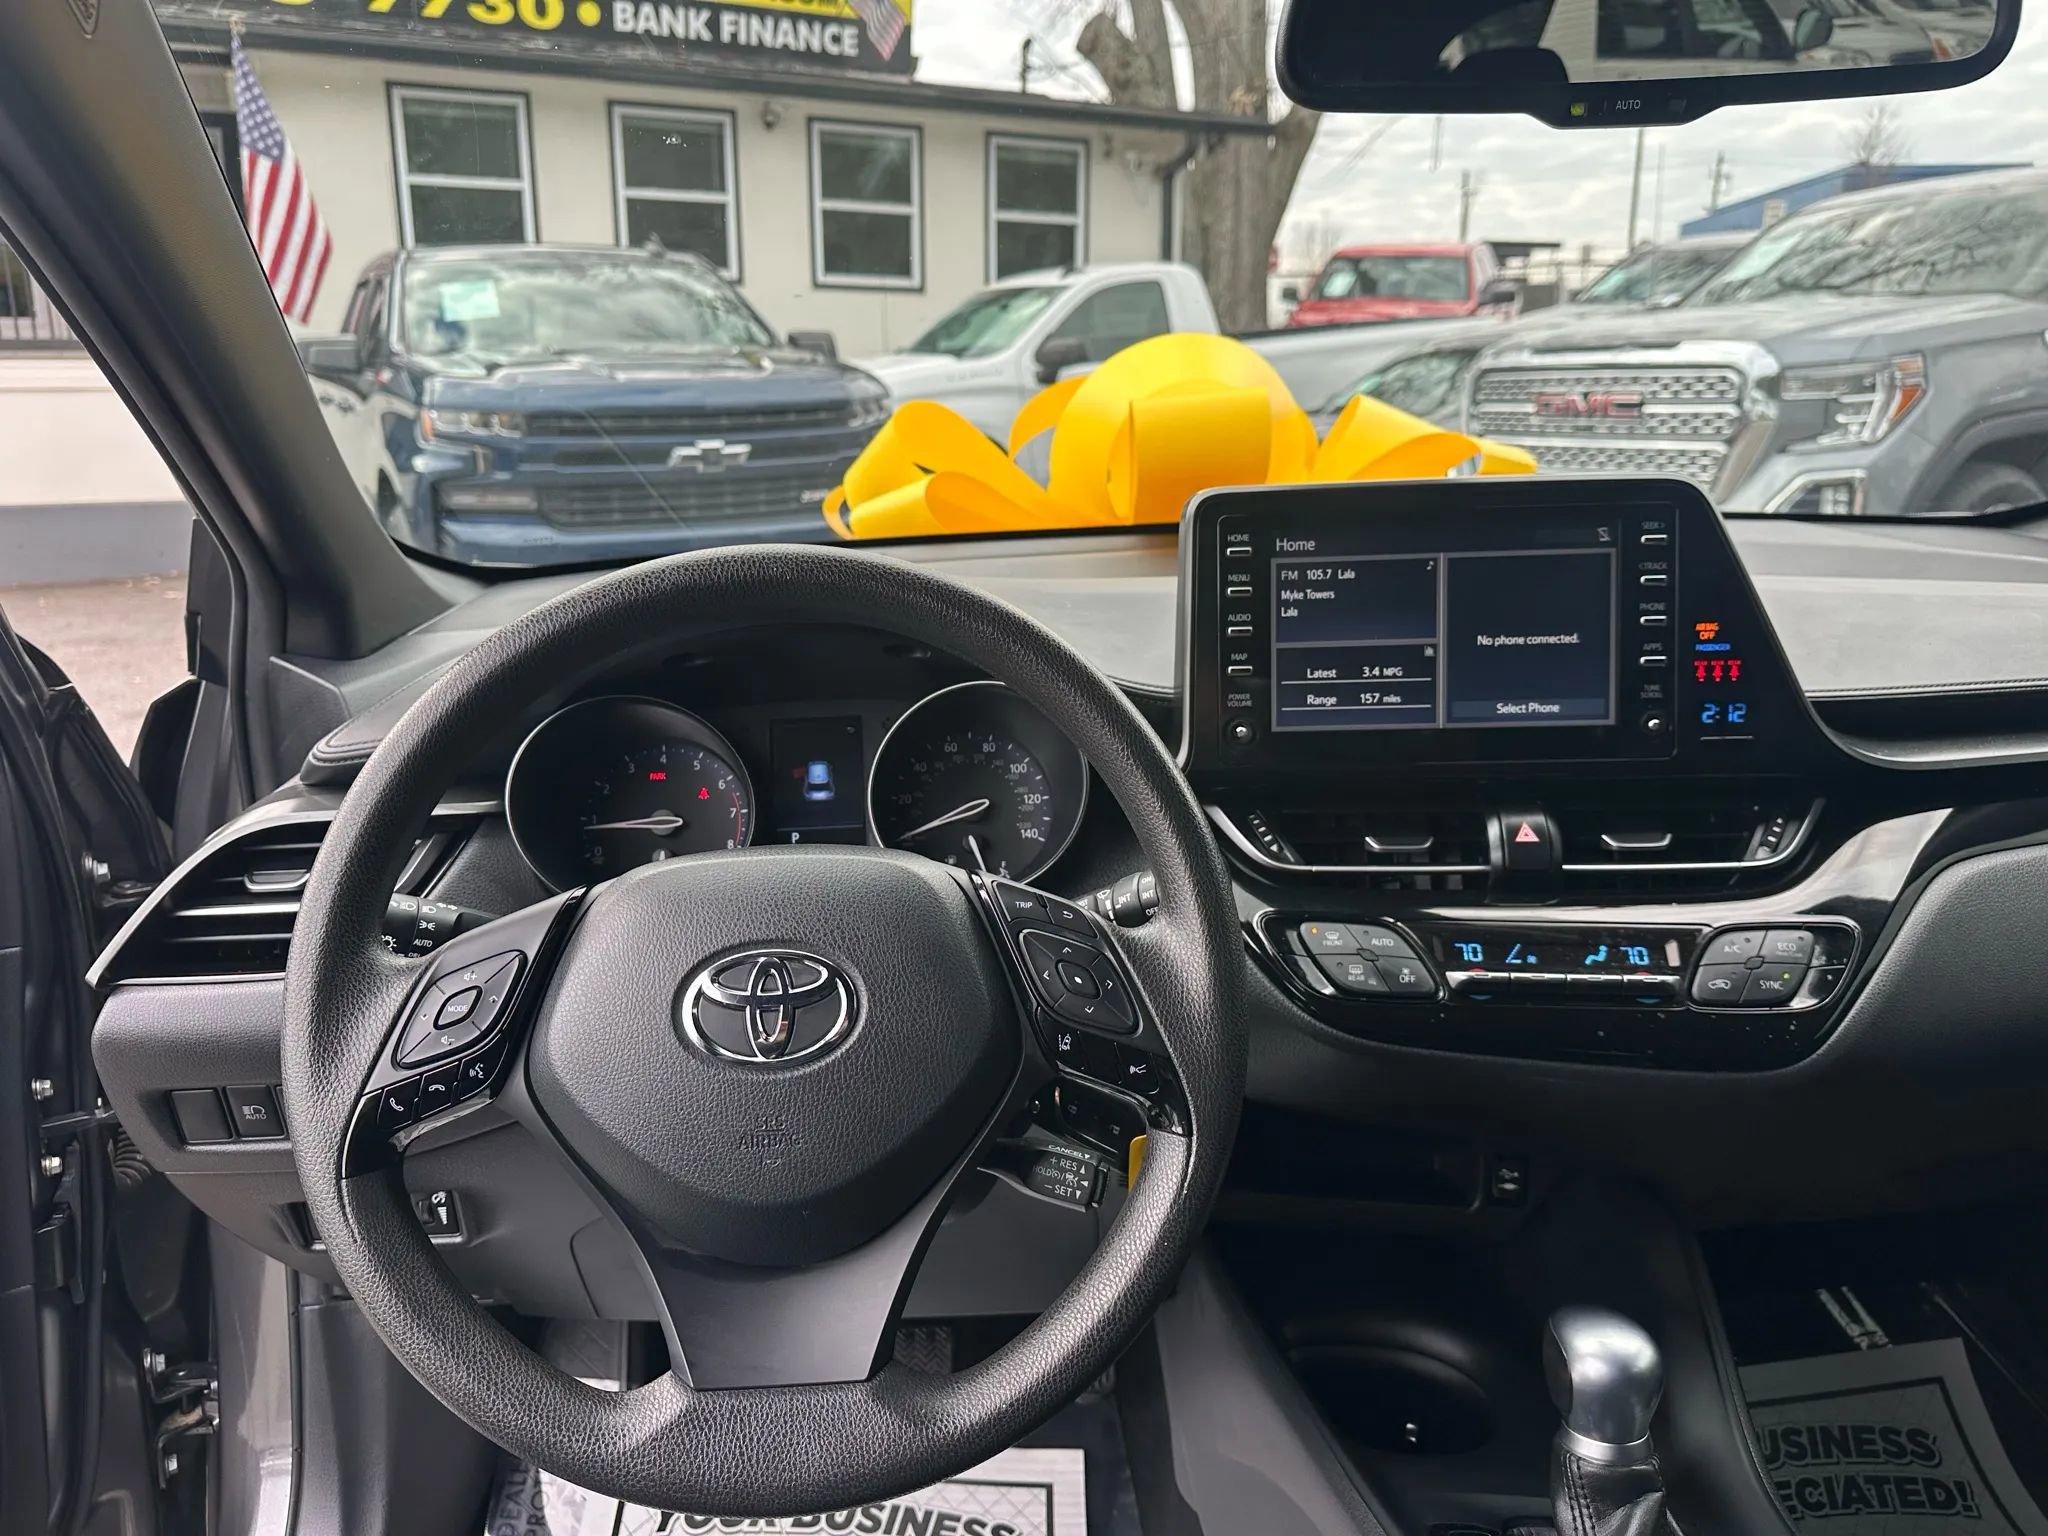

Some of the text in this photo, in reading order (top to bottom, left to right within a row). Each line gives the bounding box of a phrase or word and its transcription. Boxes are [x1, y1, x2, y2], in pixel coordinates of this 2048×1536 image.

[367, 0, 565, 31] 30
[612, 1, 859, 57] BANK FINANCE
[1616, 100, 1640, 110] AUTO
[1536, 392, 1644, 417] GMC
[1227, 534, 1250, 542] HOME
[1276, 538, 1315, 551] Home
[1228, 574, 1250, 582] MENU
[1281, 569, 1356, 580] FM 105.7 Lala
[1281, 589, 1335, 601] Myke Towers
[1228, 613, 1251, 621] AUDIO
[1281, 607, 1298, 617] Lala
[1477, 633, 1580, 647] No phone connected.
[1700, 631, 1715, 640] OFF
[1643, 643, 1662, 651] APPS
[1231, 653, 1248, 661] MAP
[1307, 666, 1402, 678] Latest 3.4 MPG
[1307, 693, 1401, 706] Range 157 miles
[1496, 702, 1560, 714] Select Phone
[1702, 703, 1747, 723] 2:12
[944, 742, 958, 752] 60
[982, 742, 996, 752] 80
[659, 754, 667, 764] 4
[628, 764, 635, 773] 3
[693, 760, 701, 770] 5
[1010, 763, 1028, 773] 100
[718, 779, 726, 789] 6
[1023, 794, 1041, 804] 120
[729, 808, 737, 818] 7
[791, 832, 800, 844] P
[1020, 828, 1039, 839] 140
[727, 839, 734, 850] 8
[1142, 889, 1154, 900] INT
[1015, 901, 1033, 909] TRIP
[413, 938, 433, 948] AUTO
[1371, 938, 1394, 946] AUTO
[1454, 943, 1484, 962] 70
[1723, 944, 1741, 953] A/C
[1777, 943, 1797, 952] ECO
[1620, 946, 1650, 966] 70
[1399, 975, 1417, 983] OFF
[1759, 980, 1784, 990] SYNC
[1048, 1144, 1084, 1159] CANCEL
[1060, 1158, 1078, 1171] RES
[1054, 1185, 1073, 1197] SET
